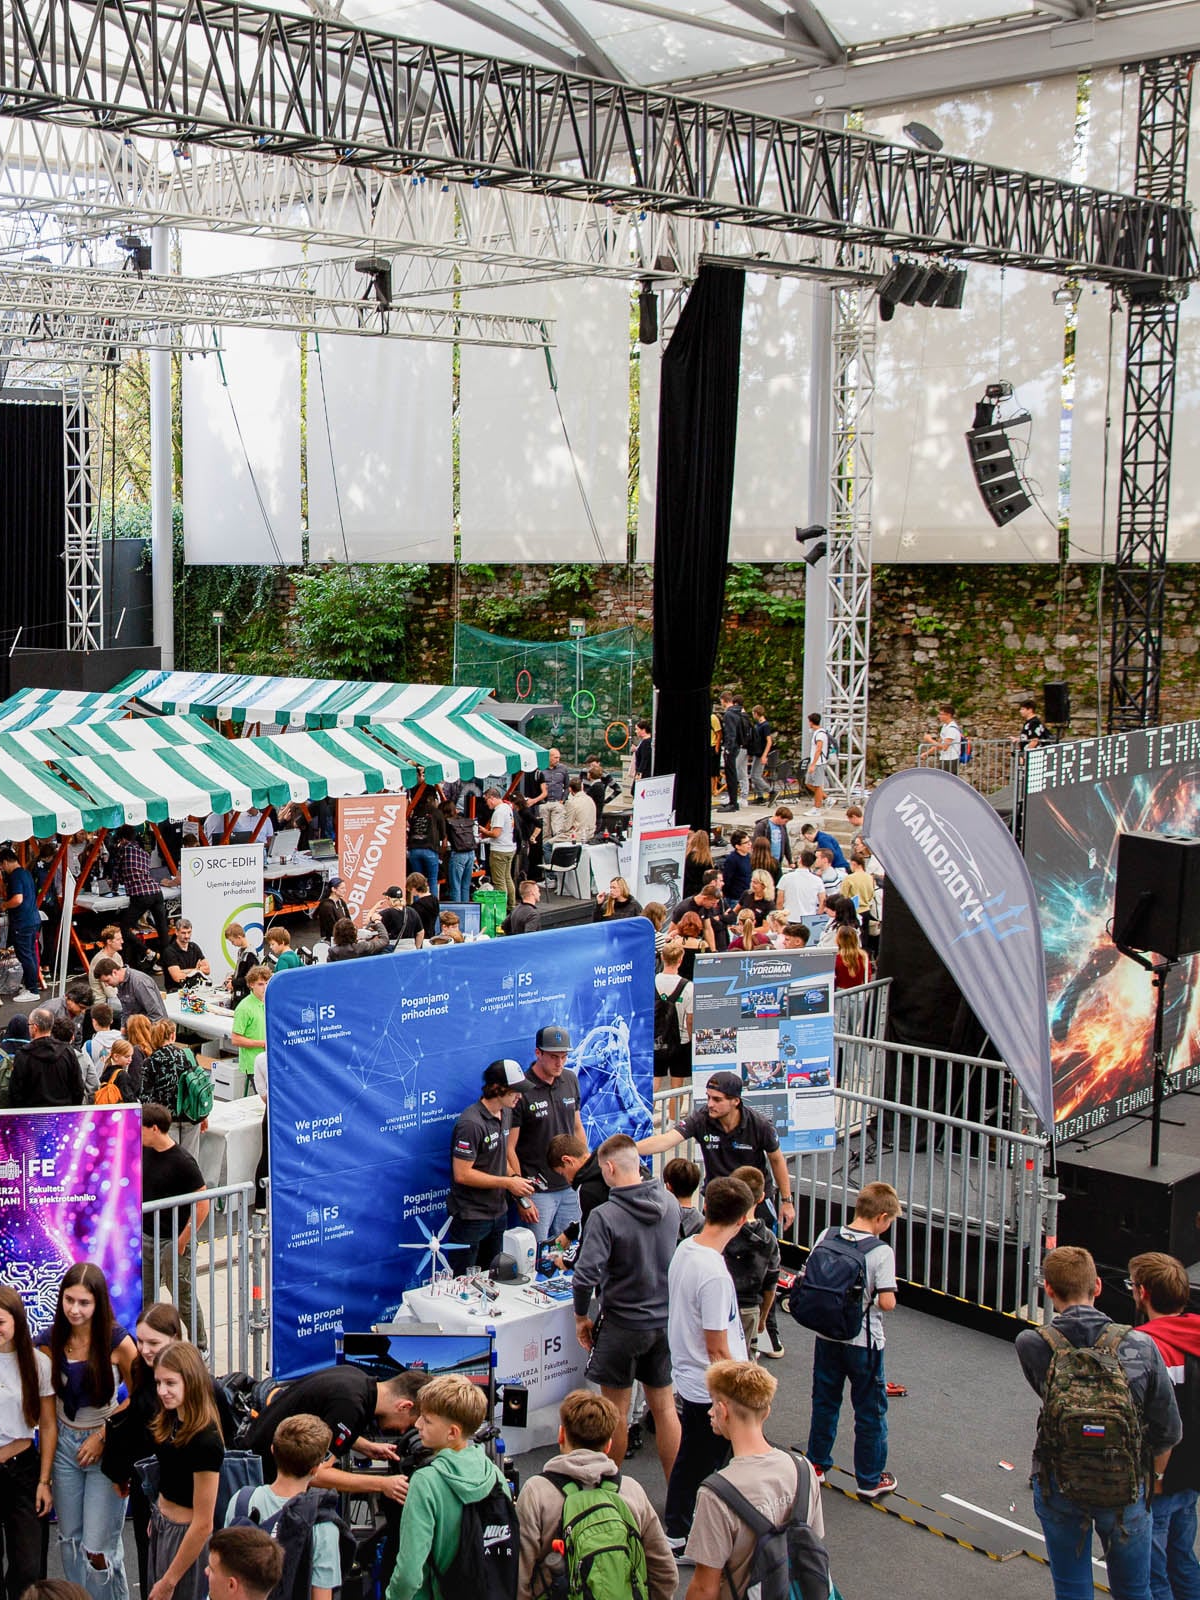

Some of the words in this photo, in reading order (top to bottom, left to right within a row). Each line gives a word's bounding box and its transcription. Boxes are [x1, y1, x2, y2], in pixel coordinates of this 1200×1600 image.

[1042, 735, 1128, 790] ARENA
[206, 857, 256, 869] SRC-EDIH
[231, 879, 256, 887] digitalno
[594, 965, 606, 975] We
[608, 961, 632, 974] propel
[518, 973, 532, 986] FS
[594, 978, 606, 988] the
[608, 975, 632, 985] Future
[401, 992, 449, 1008] Poganjamo
[319, 1005, 335, 1020] FS
[401, 1005, 449, 1023] prihodnost
[421, 1090, 436, 1105] FS
[295, 1120, 310, 1130] We
[312, 1113, 342, 1130] propel
[386, 1113, 417, 1124] UNIVERSITY
[422, 1115, 446, 1124] Mechanical
[296, 1134, 310, 1144] the
[312, 1127, 342, 1142] Future
[28, 1159, 55, 1177] FE
[29, 1185, 64, 1193] Fakulteta
[39, 1194, 96, 1203] elektrotehniko
[323, 1206, 339, 1221] FS
[403, 1201, 447, 1219] prihodnos
[291, 1230, 319, 1240] UNIVERZA
[292, 1237, 319, 1248] LJUBLJANI
[298, 1314, 312, 1324] We
[313, 1305, 344, 1322] propel
[297, 1327, 312, 1338] the
[314, 1319, 342, 1333] Future
[544, 1336, 561, 1355] FS
[544, 1360, 568, 1370] Fakulteta
[483, 1524, 511, 1538] NIKE
[484, 1547, 512, 1556] AIR
